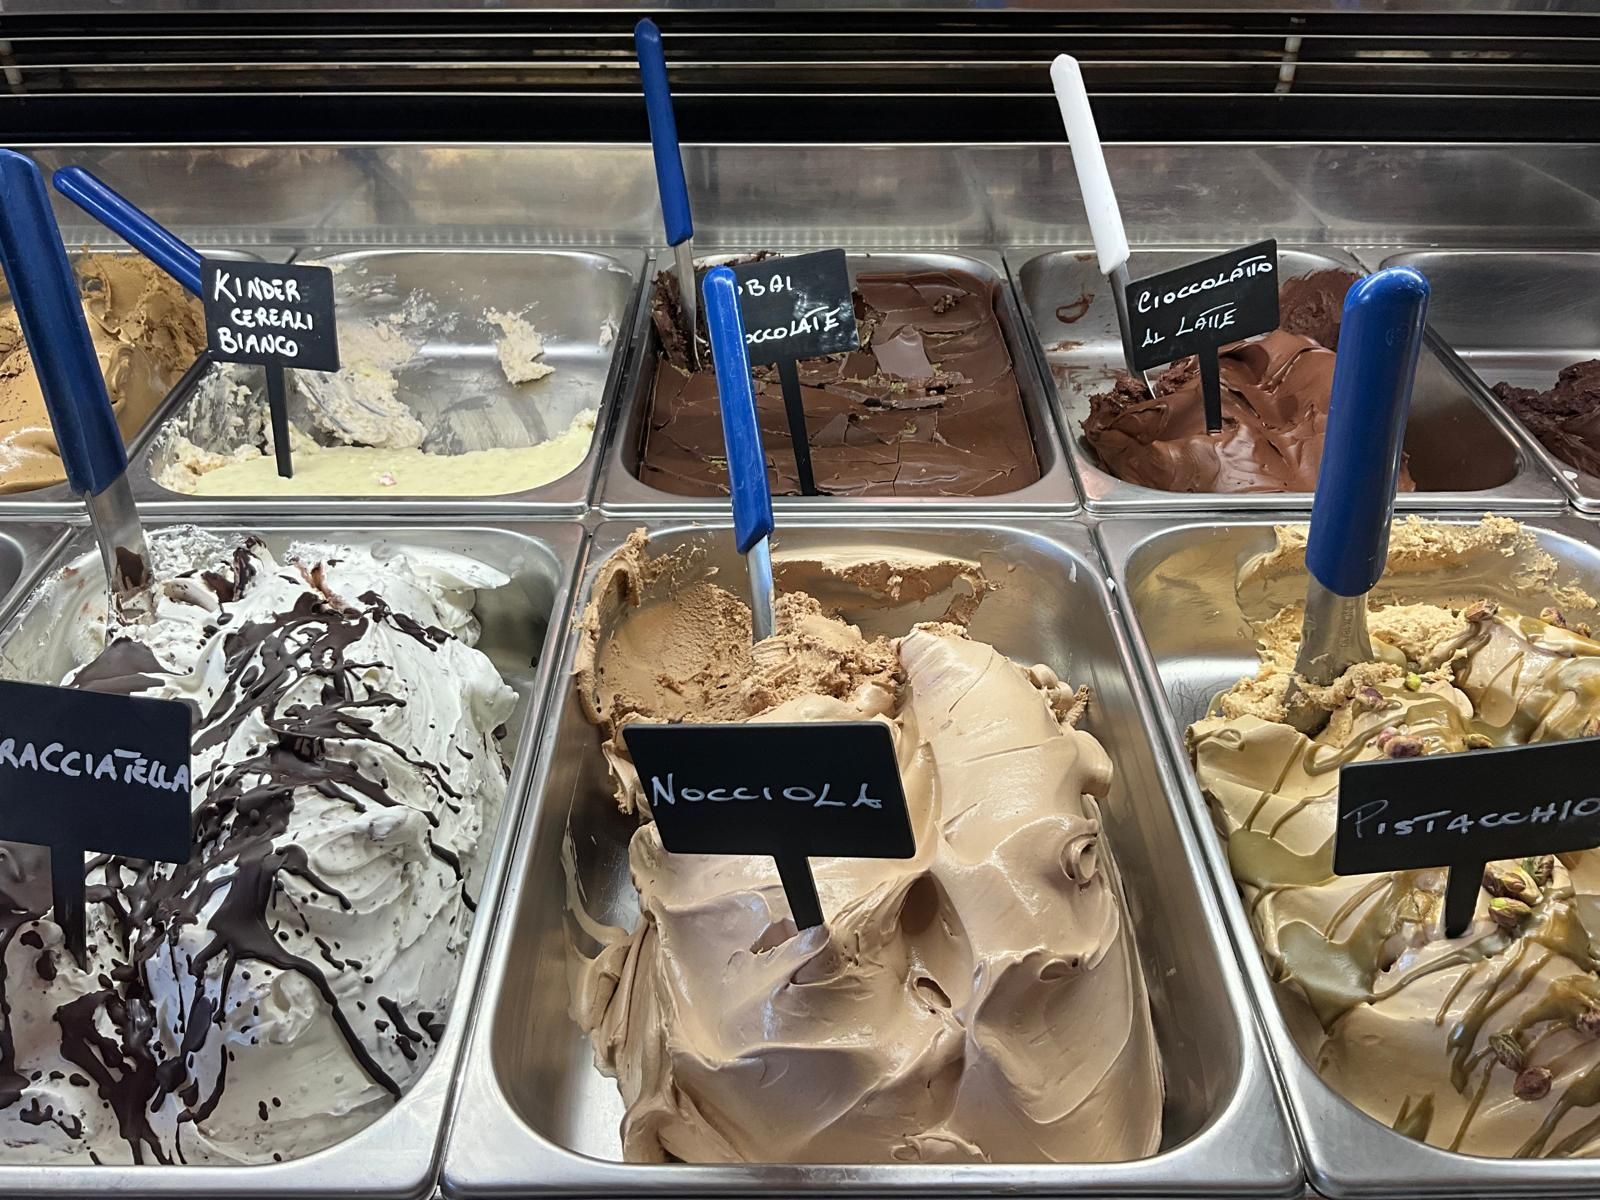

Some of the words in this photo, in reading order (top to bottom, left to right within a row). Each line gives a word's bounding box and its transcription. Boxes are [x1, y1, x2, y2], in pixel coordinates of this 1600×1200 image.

[214, 268, 301, 303] KINDER
[737, 274, 793, 297] BAI
[1137, 255, 1273, 313] CIOCCOLATTO
[230, 306, 313, 330] CEREALI
[745, 305, 841, 344] OCCOLATE
[1141, 328, 1165, 348] AL
[1175, 301, 1238, 337] LATTE
[217, 326, 299, 357] BIANCO
[0, 738, 190, 793] RACCIATELLA
[651, 773, 882, 809] NOCCIOLA
[1343, 798, 1600, 838] PISTACCHIO
